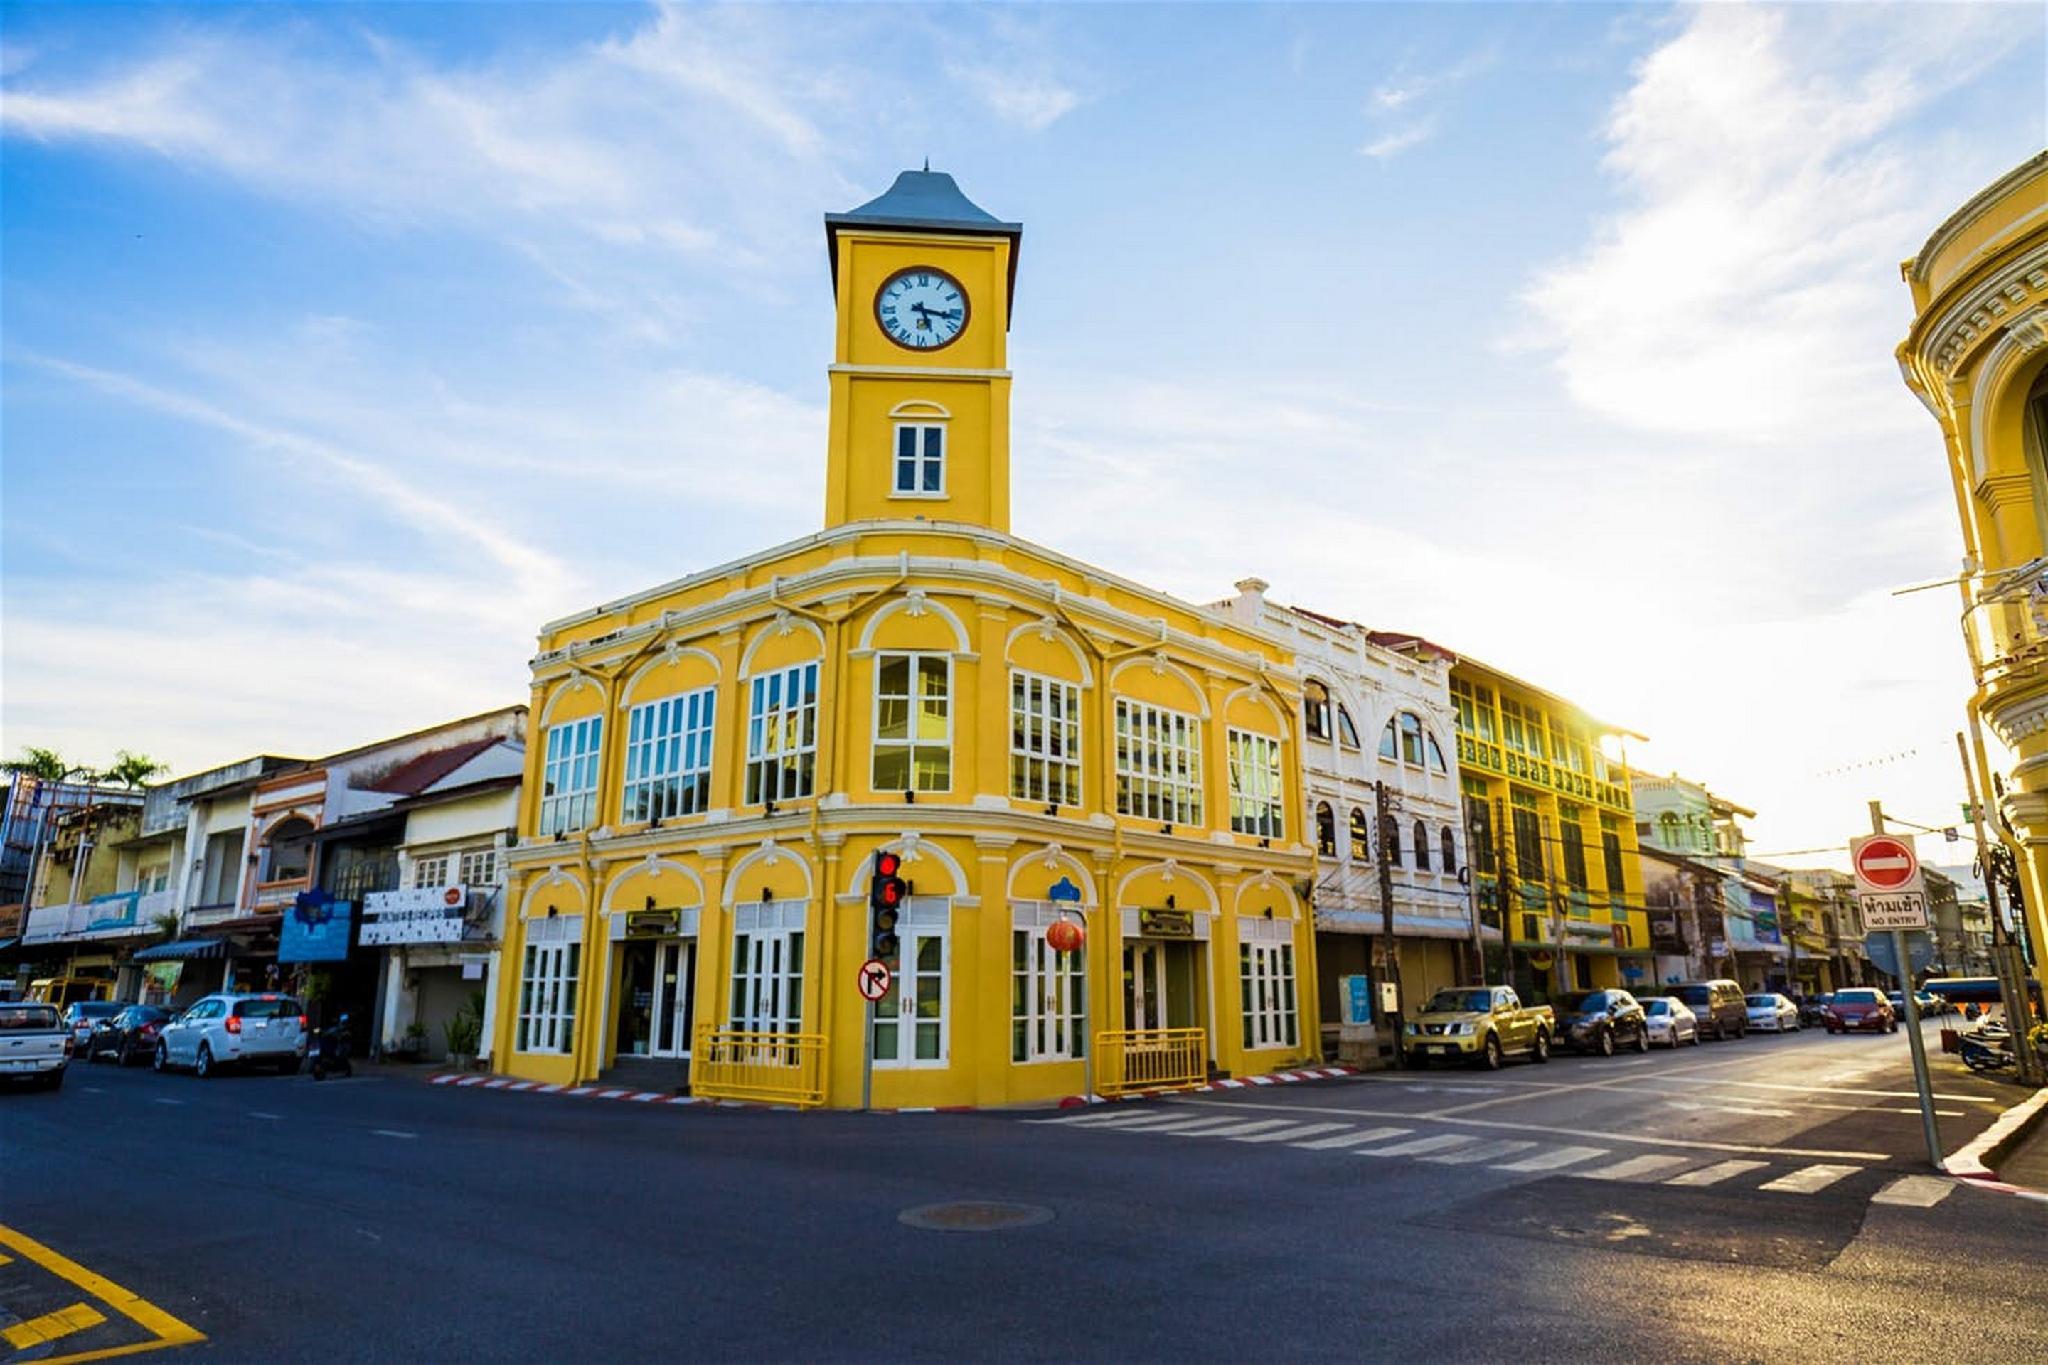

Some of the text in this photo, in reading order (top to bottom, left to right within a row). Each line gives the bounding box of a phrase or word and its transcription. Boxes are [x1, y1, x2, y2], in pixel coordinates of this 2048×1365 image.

[917, 274, 929, 287] XII
[887, 289, 901, 300] X
[917, 335, 927, 347] VI
[936, 333, 945, 345] V
[1864, 895, 1922, 913] ห้ามเข้า
[1871, 916, 1917, 925] NO ENTRY
